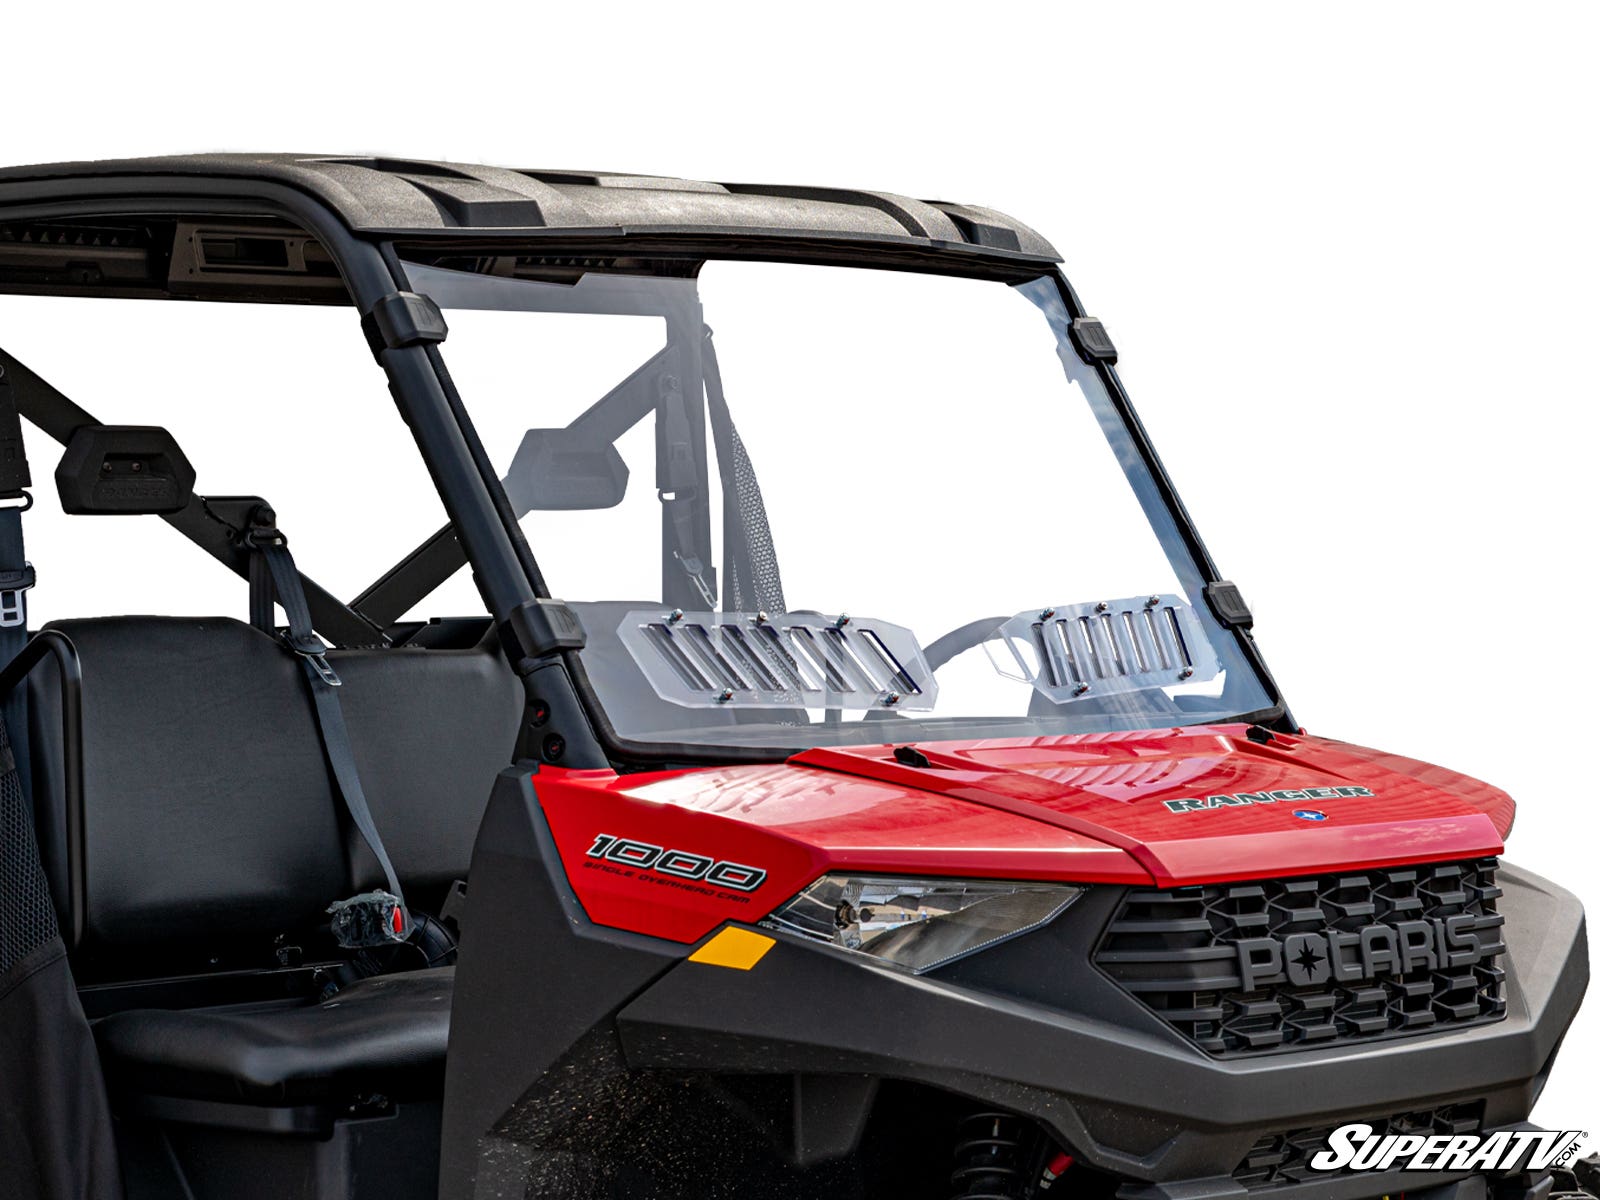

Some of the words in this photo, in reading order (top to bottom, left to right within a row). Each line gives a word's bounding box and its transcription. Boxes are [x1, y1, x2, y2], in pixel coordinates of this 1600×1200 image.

[1162, 785, 1376, 814] RANGER
[582, 860, 636, 878] SINGLE
[638, 873, 716, 897] OVERHEAD
[716, 890, 751, 905] CAM
[585, 833, 767, 893] 1000
[1235, 914, 1482, 993] POLARIS
